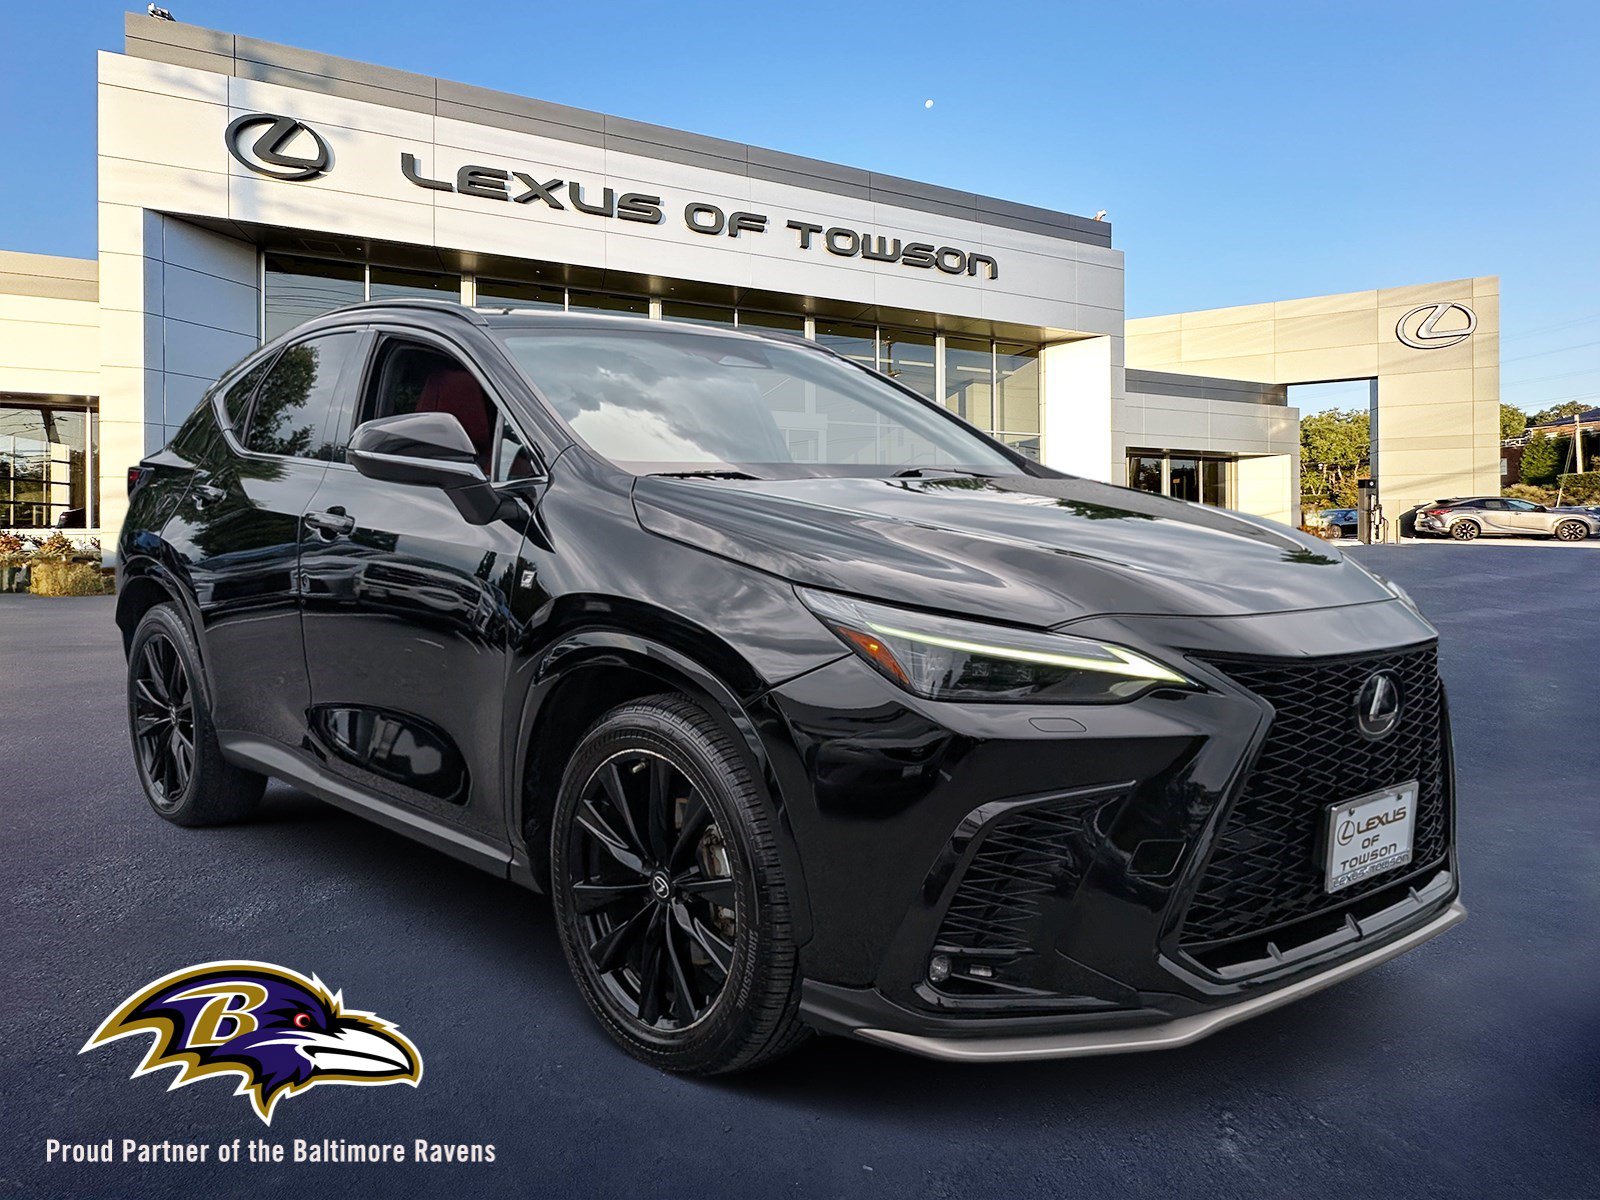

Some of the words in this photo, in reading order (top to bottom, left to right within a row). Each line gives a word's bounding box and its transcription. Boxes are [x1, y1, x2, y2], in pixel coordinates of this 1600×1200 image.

[401, 152, 663, 225] LEXUS
[684, 202, 767, 237] OF
[787, 219, 998, 280] TOWSON
[1356, 807, 1407, 834] LEXUS
[1361, 834, 1380, 850] OF
[1340, 843, 1397, 872] TOWSON
[736, 929, 759, 1012] BRIDGESTONE
